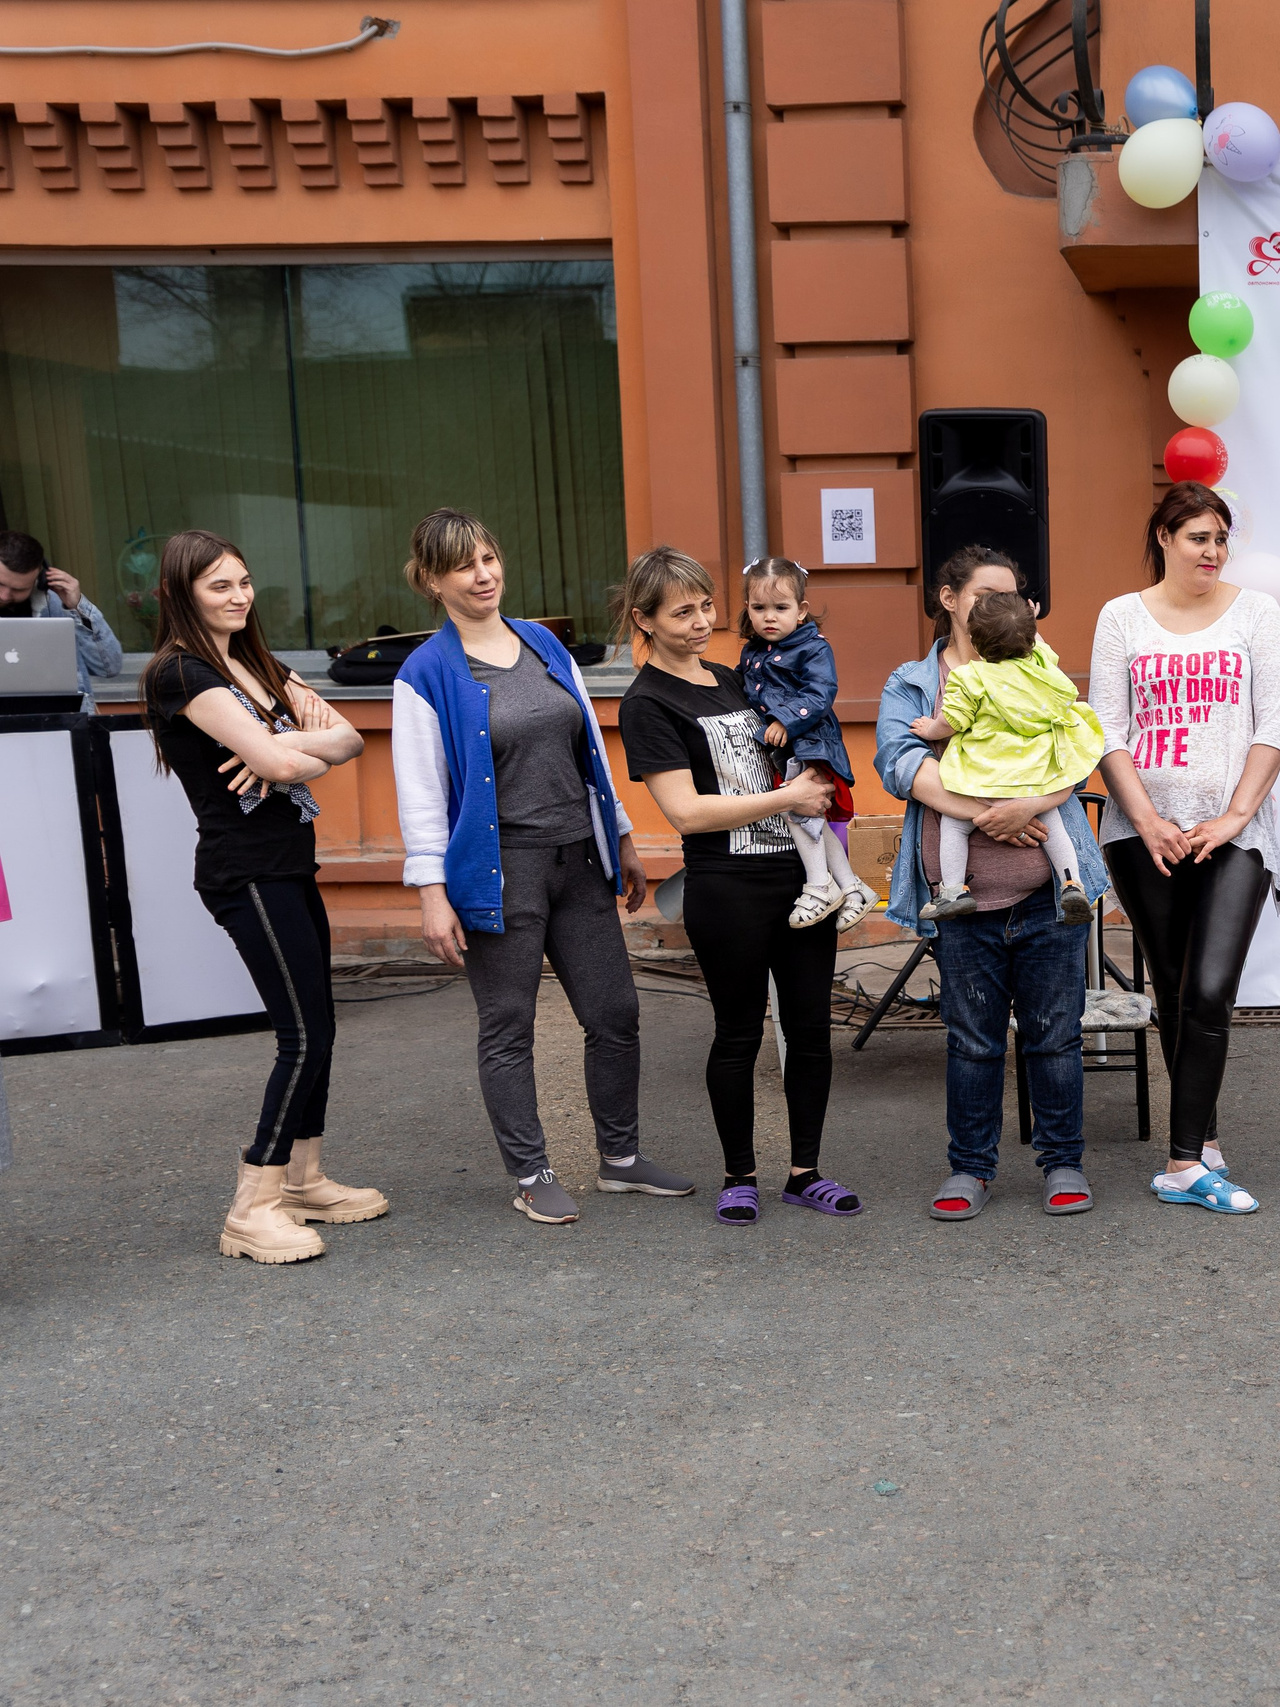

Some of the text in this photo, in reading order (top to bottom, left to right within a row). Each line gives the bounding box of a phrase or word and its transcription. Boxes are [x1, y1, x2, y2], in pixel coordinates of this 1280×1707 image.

[1134, 677, 1240, 709] IS MY DRUG
[1168, 706, 1183, 725] IS
[1189, 705, 1212, 723] MY
[1132, 727, 1189, 770] LIFE
